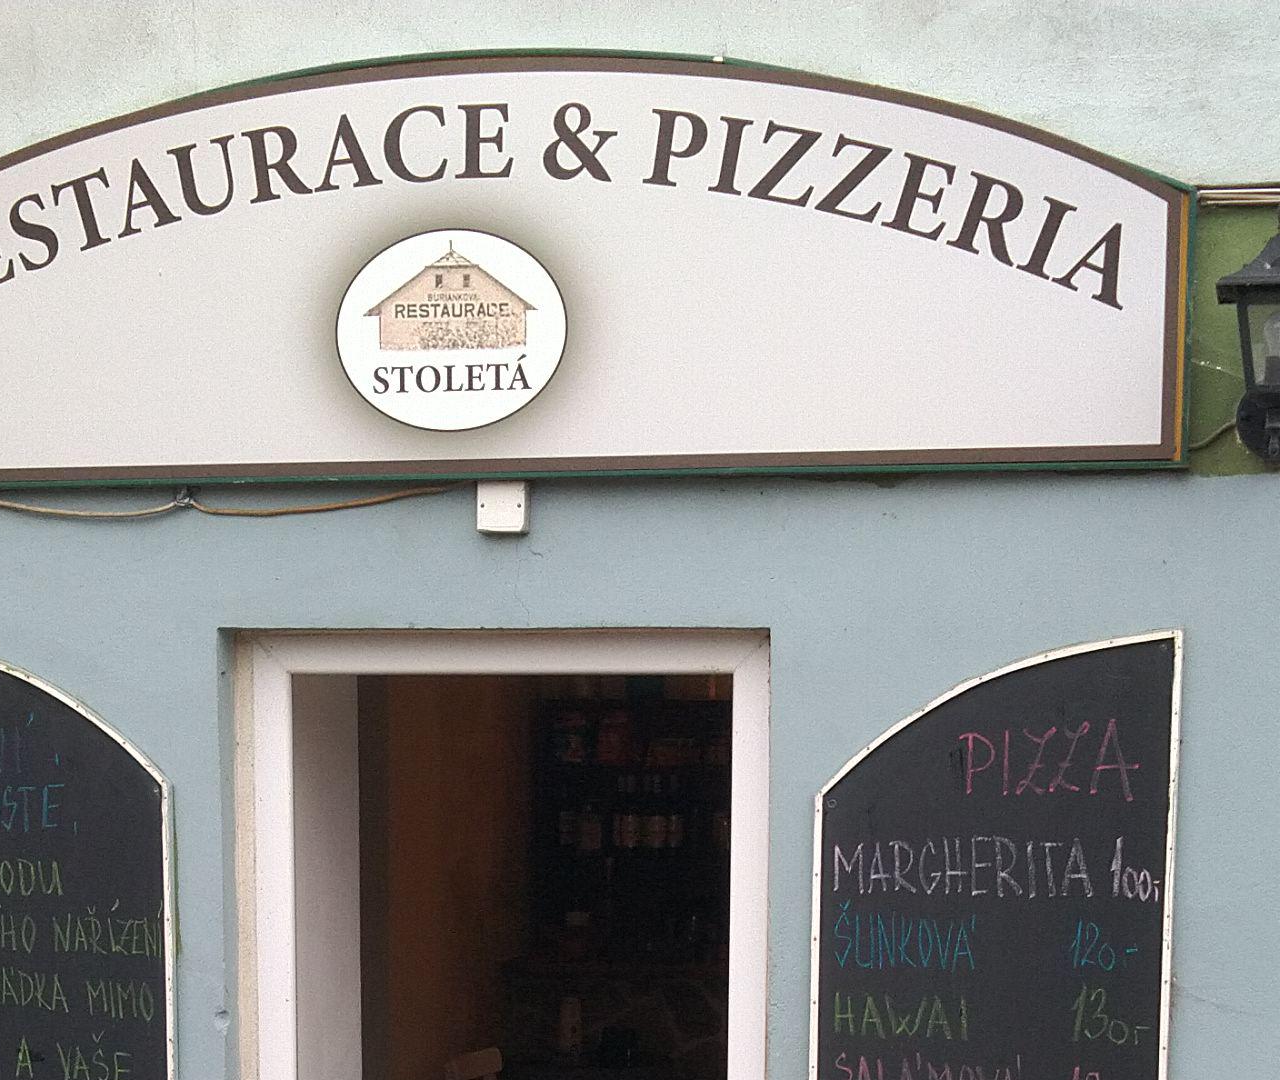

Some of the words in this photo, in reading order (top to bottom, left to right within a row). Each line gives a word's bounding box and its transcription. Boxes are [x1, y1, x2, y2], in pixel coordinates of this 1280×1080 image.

[543, 102, 617, 183] &
[642, 108, 1130, 311] PIZZERIA
[394, 302, 510, 318] RESTAURACE
[373, 353, 532, 394] STOLETÁ
[959, 718, 1142, 802] PIZZA
[833, 835, 1094, 899] MARGHERITA
[86, 979, 156, 1022] MIMO
[834, 991, 968, 1040] HAWAI
[16, 1037, 33, 1078] A
